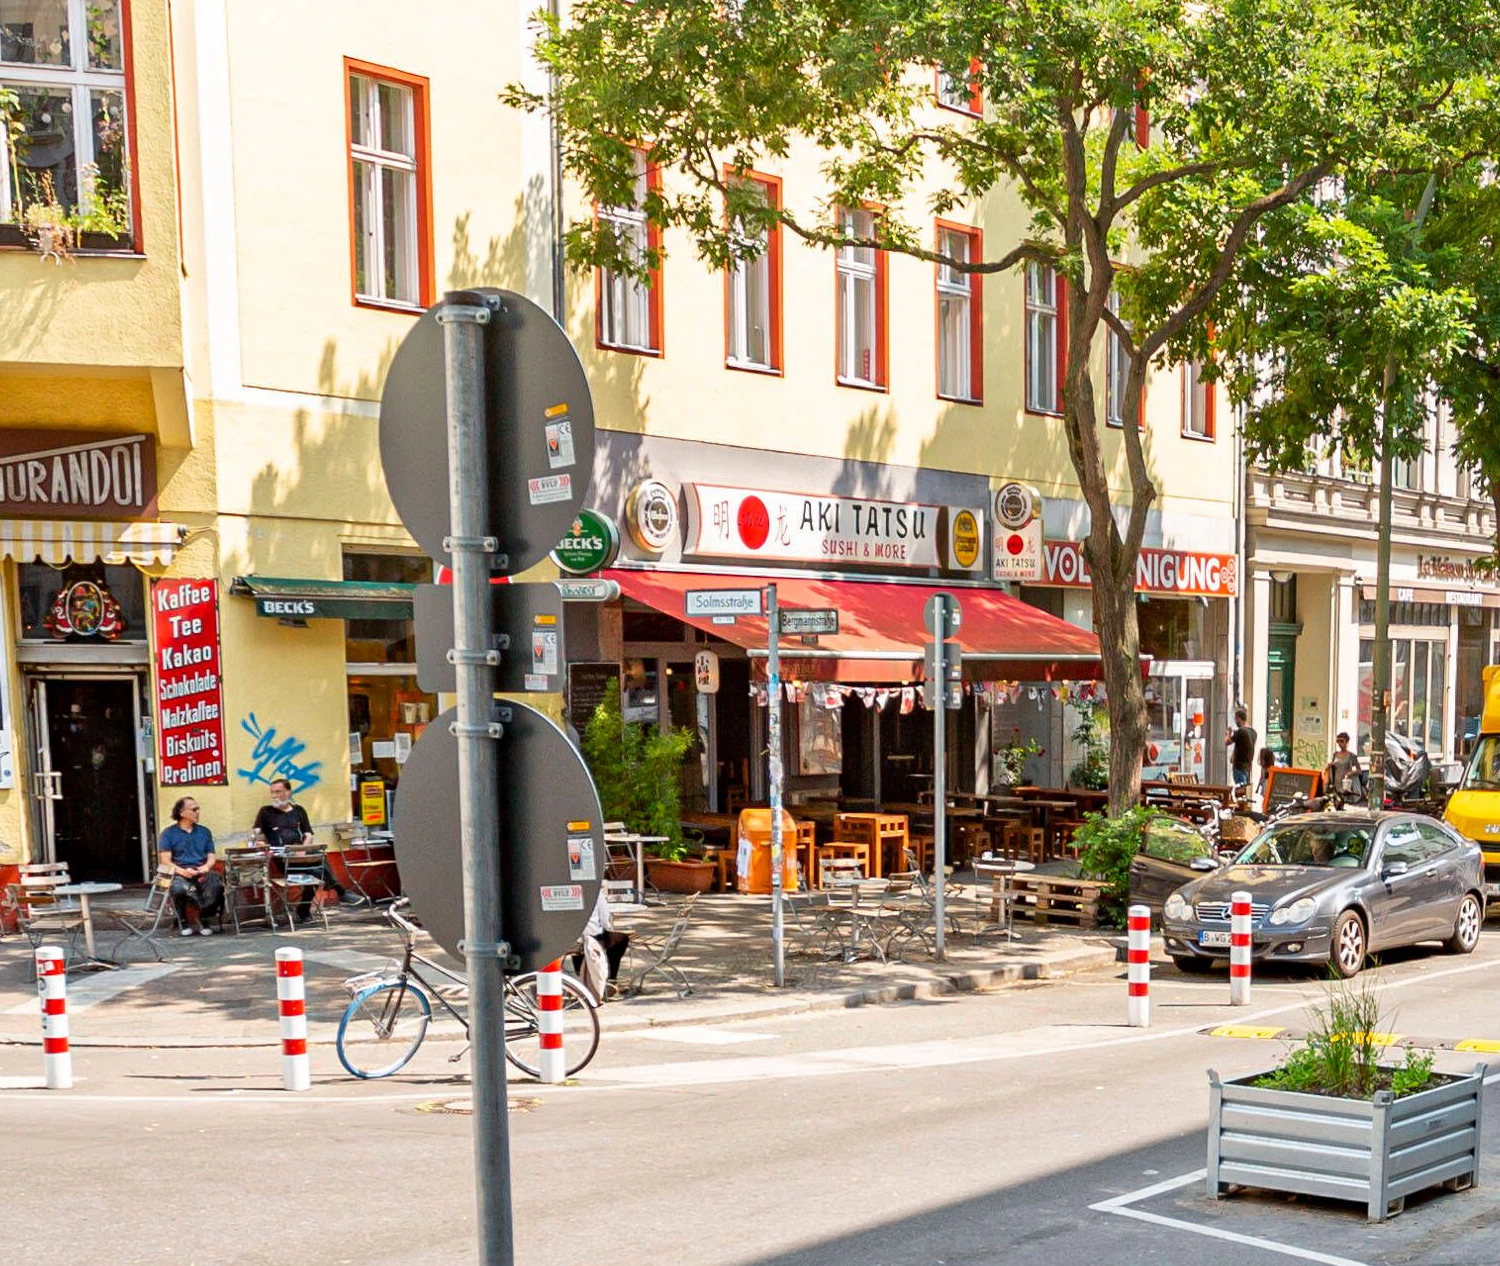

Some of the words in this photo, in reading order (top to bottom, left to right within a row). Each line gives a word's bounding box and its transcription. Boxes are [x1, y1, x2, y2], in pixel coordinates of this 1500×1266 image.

[800, 499, 841, 534] AKI
[852, 504, 926, 540] TATSU
[822, 538, 858, 557] SUSHI
[863, 543, 871, 557] &
[874, 543, 907, 560] MORE
[995, 558, 1009, 567] AKI
[1011, 558, 1036, 568] TATSU
[157, 585, 211, 612] Kaffee
[263, 600, 316, 614] BECK'S
[695, 594, 755, 610] Solmsstraße
[169, 615, 203, 640] Tee
[781, 613, 835, 630] Bergmannstraße
[161, 643, 213, 671] Kakao
[159, 669, 217, 701] Schokolade
[161, 700, 219, 730] Malzkaffee
[165, 730, 218, 758] Biskuits
[163, 759, 222, 785] Pralinen
